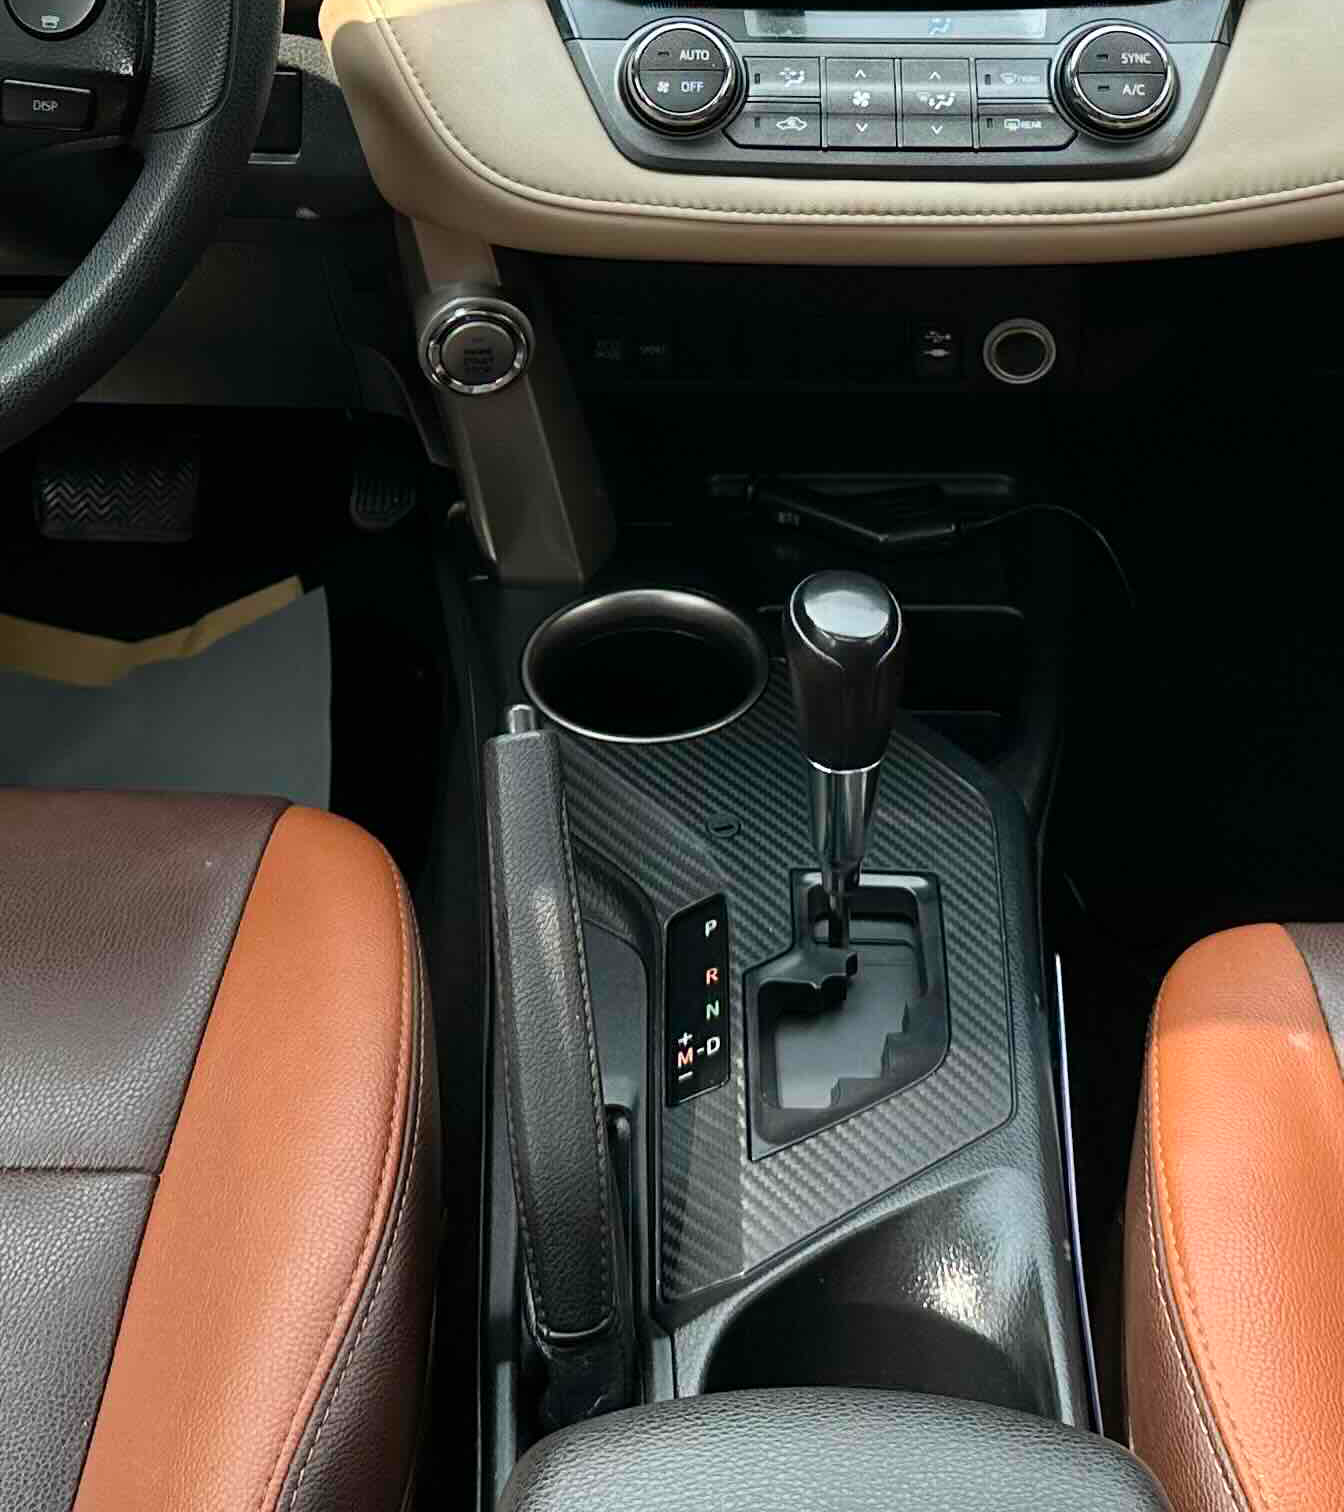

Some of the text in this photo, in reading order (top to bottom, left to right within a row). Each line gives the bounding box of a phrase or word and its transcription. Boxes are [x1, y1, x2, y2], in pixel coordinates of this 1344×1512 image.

[679, 49, 710, 61] AUTO
[1121, 52, 1152, 65] SYNC
[681, 80, 705, 93] OFF
[1122, 84, 1146, 96] A/C
[32, 99, 58, 112] DISP
[704, 919, 718, 938] P
[705, 967, 719, 985] R
[705, 999, 720, 1020] N
[706, 1035, 721, 1056] D
[677, 1047, 694, 1069] M
